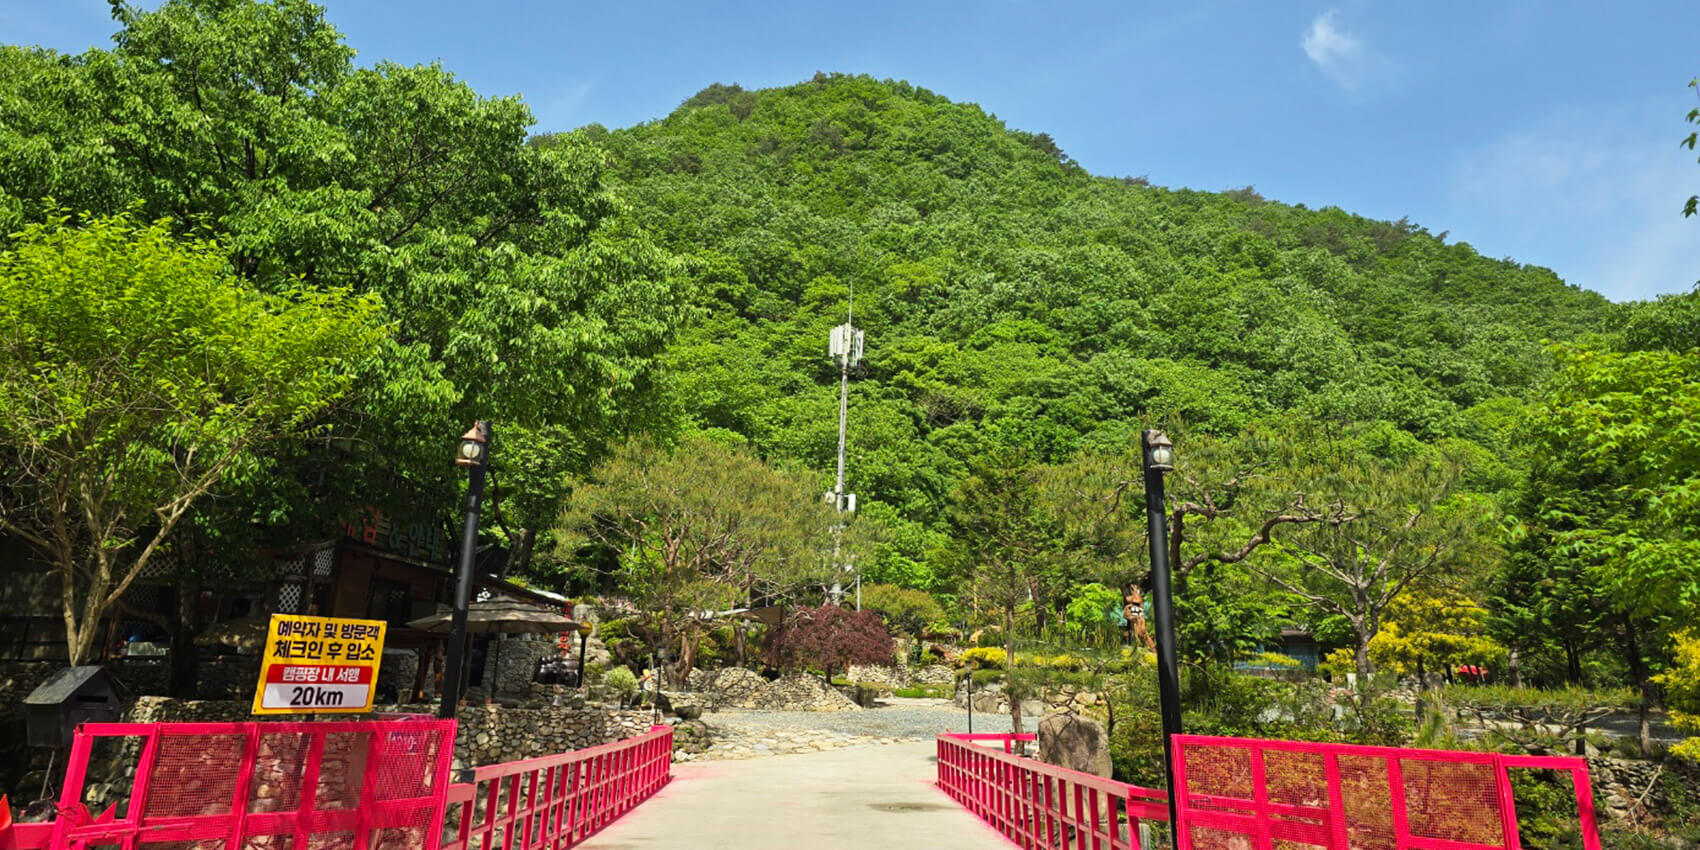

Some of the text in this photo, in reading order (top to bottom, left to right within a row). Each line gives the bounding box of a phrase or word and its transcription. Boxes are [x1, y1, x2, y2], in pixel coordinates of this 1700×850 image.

[277, 620, 380, 640] 예약자 및 방문객
[272, 640, 376, 661] 체크인 후 입소
[282, 666, 320, 682] 캠핑장
[321, 667, 335, 681] 내
[290, 686, 344, 706] 20km
